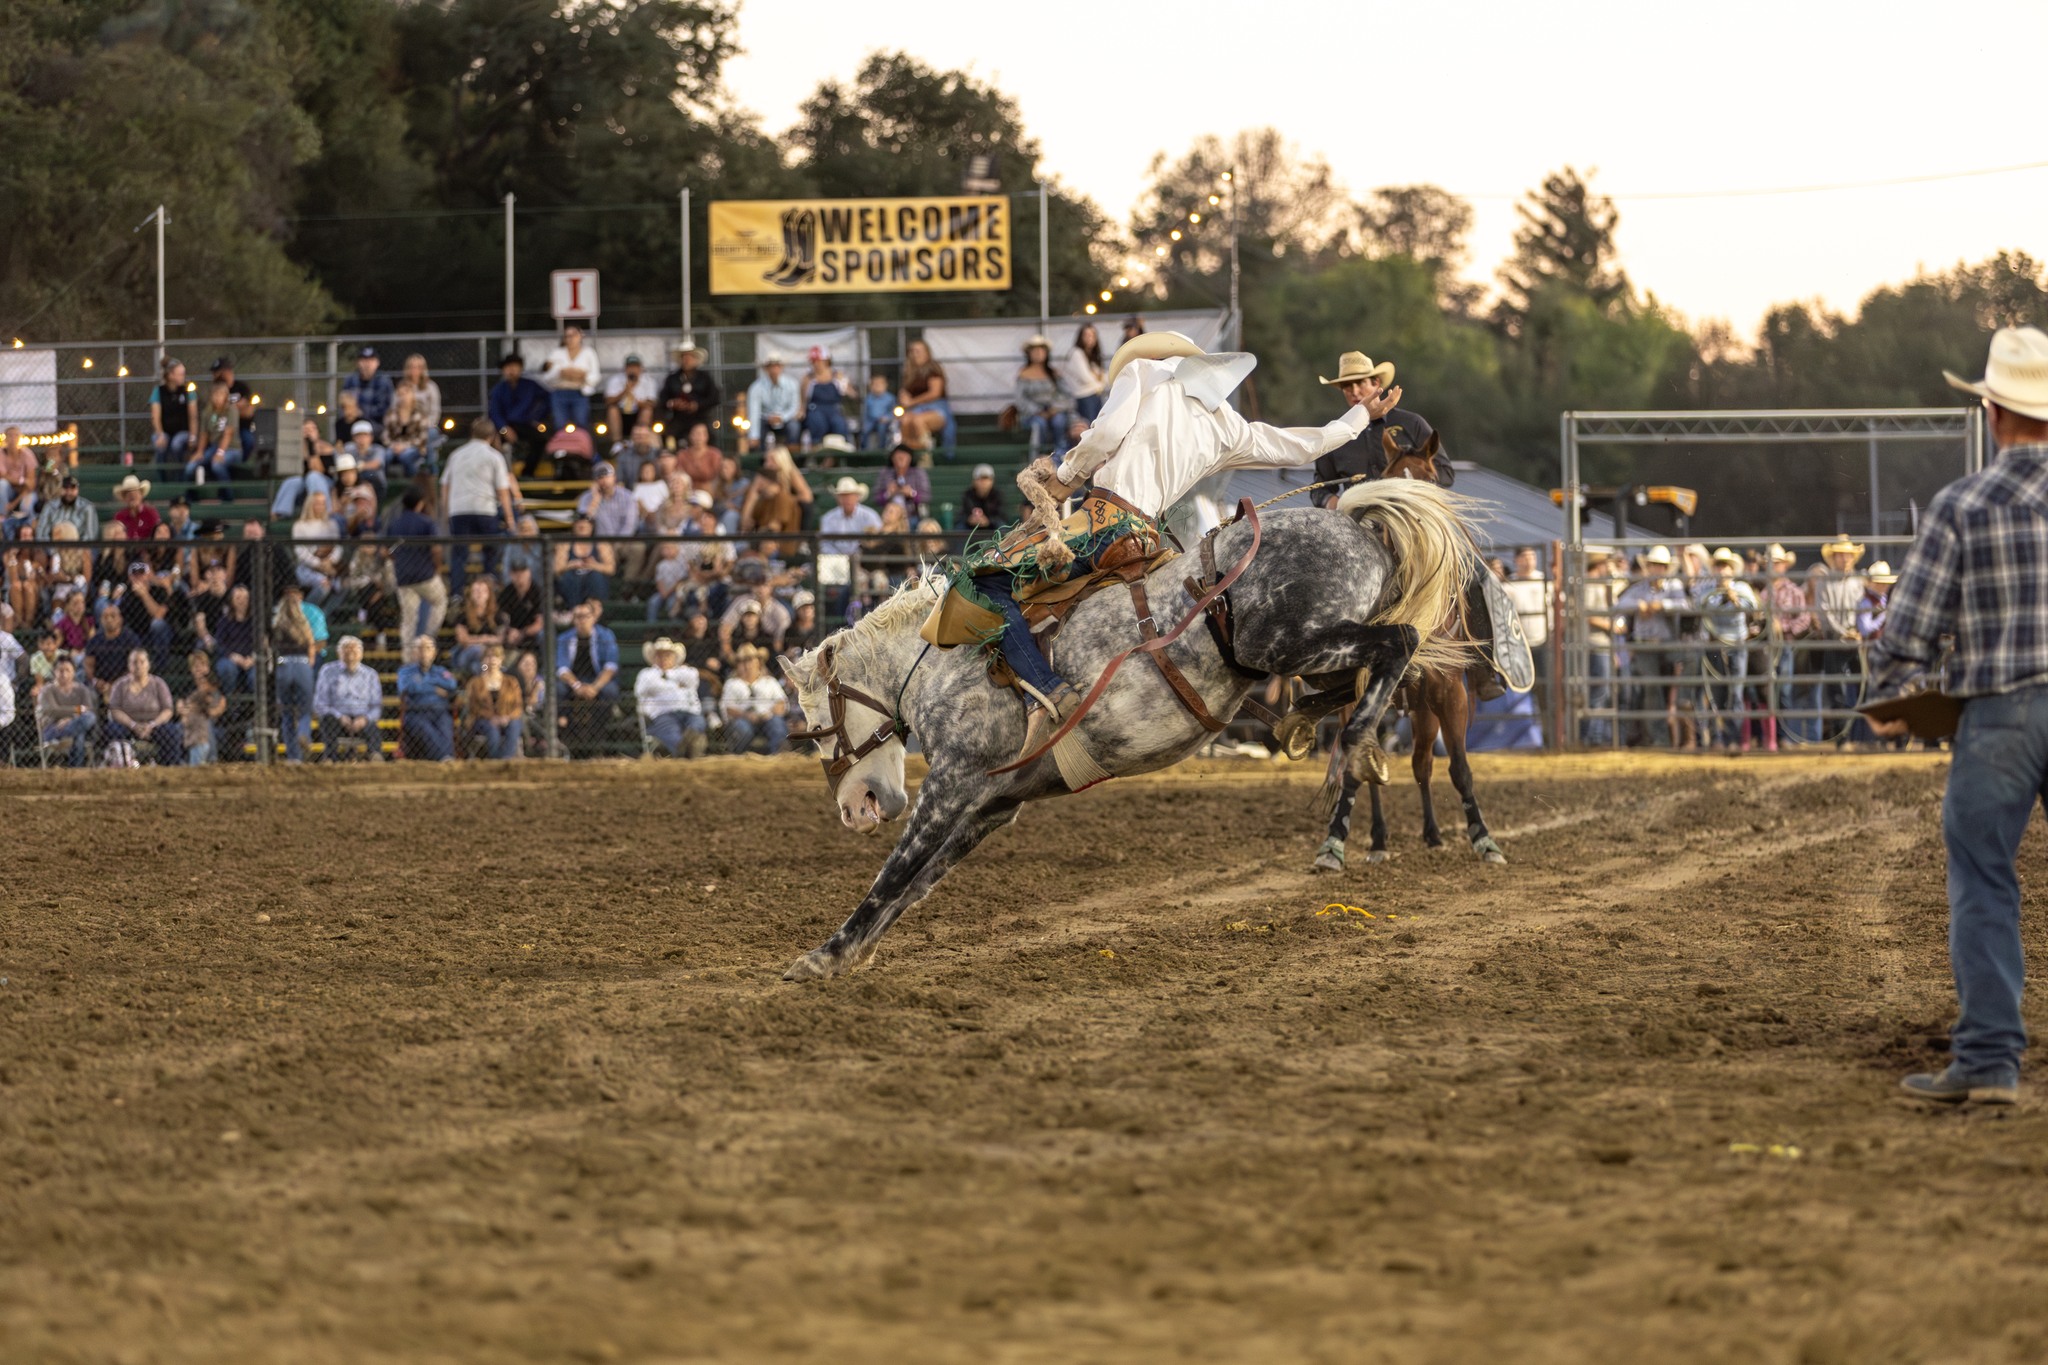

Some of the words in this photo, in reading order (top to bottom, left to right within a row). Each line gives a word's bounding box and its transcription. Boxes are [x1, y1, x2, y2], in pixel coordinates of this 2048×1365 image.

[820, 205, 1002, 243] WELCOME
[821, 247, 1004, 283] SPONSORS
[567, 278, 583, 311] I
